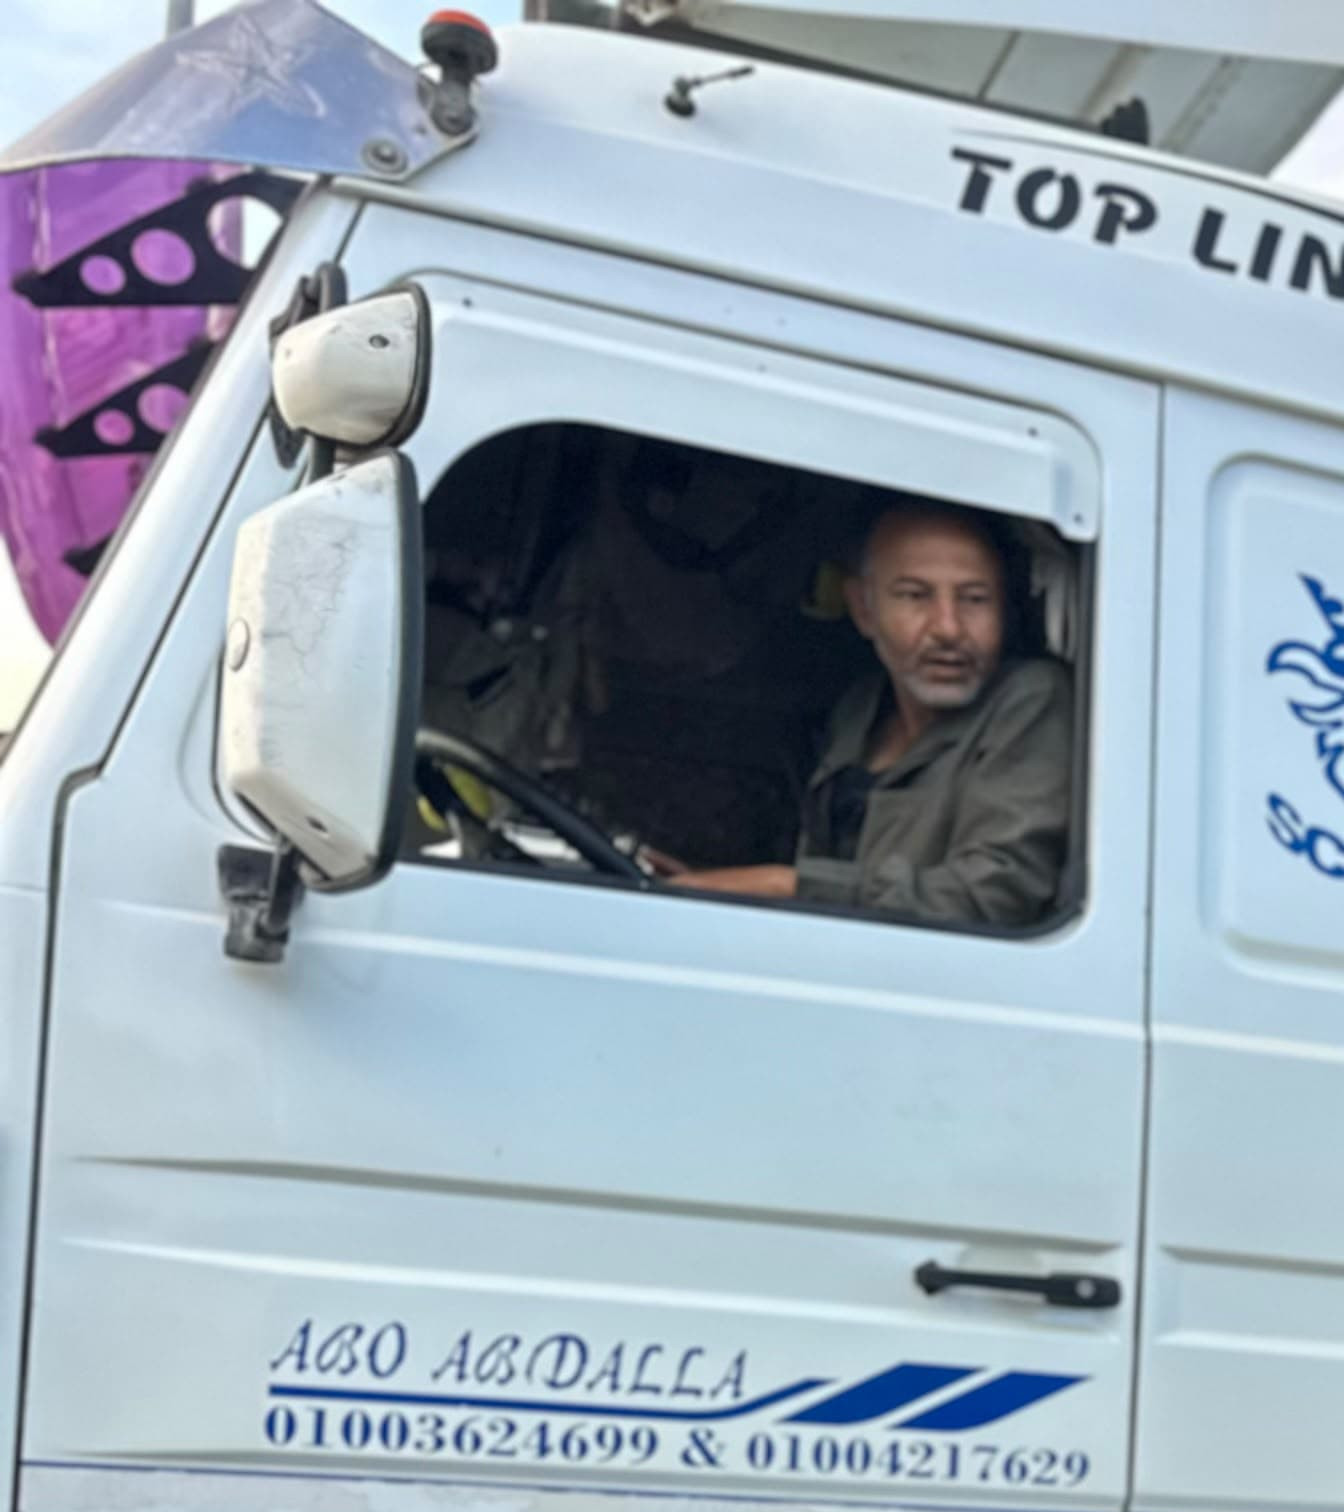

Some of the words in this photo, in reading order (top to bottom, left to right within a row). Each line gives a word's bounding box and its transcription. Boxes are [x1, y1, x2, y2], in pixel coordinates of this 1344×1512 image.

[951, 147, 1158, 246] TOP
[269, 1318, 408, 1380] ABO
[431, 1329, 749, 1400] ABDALLA
[264, 1405, 660, 1465] 01003624699
[679, 1426, 727, 1469] &
[745, 1430, 1091, 1488] 01004217629
